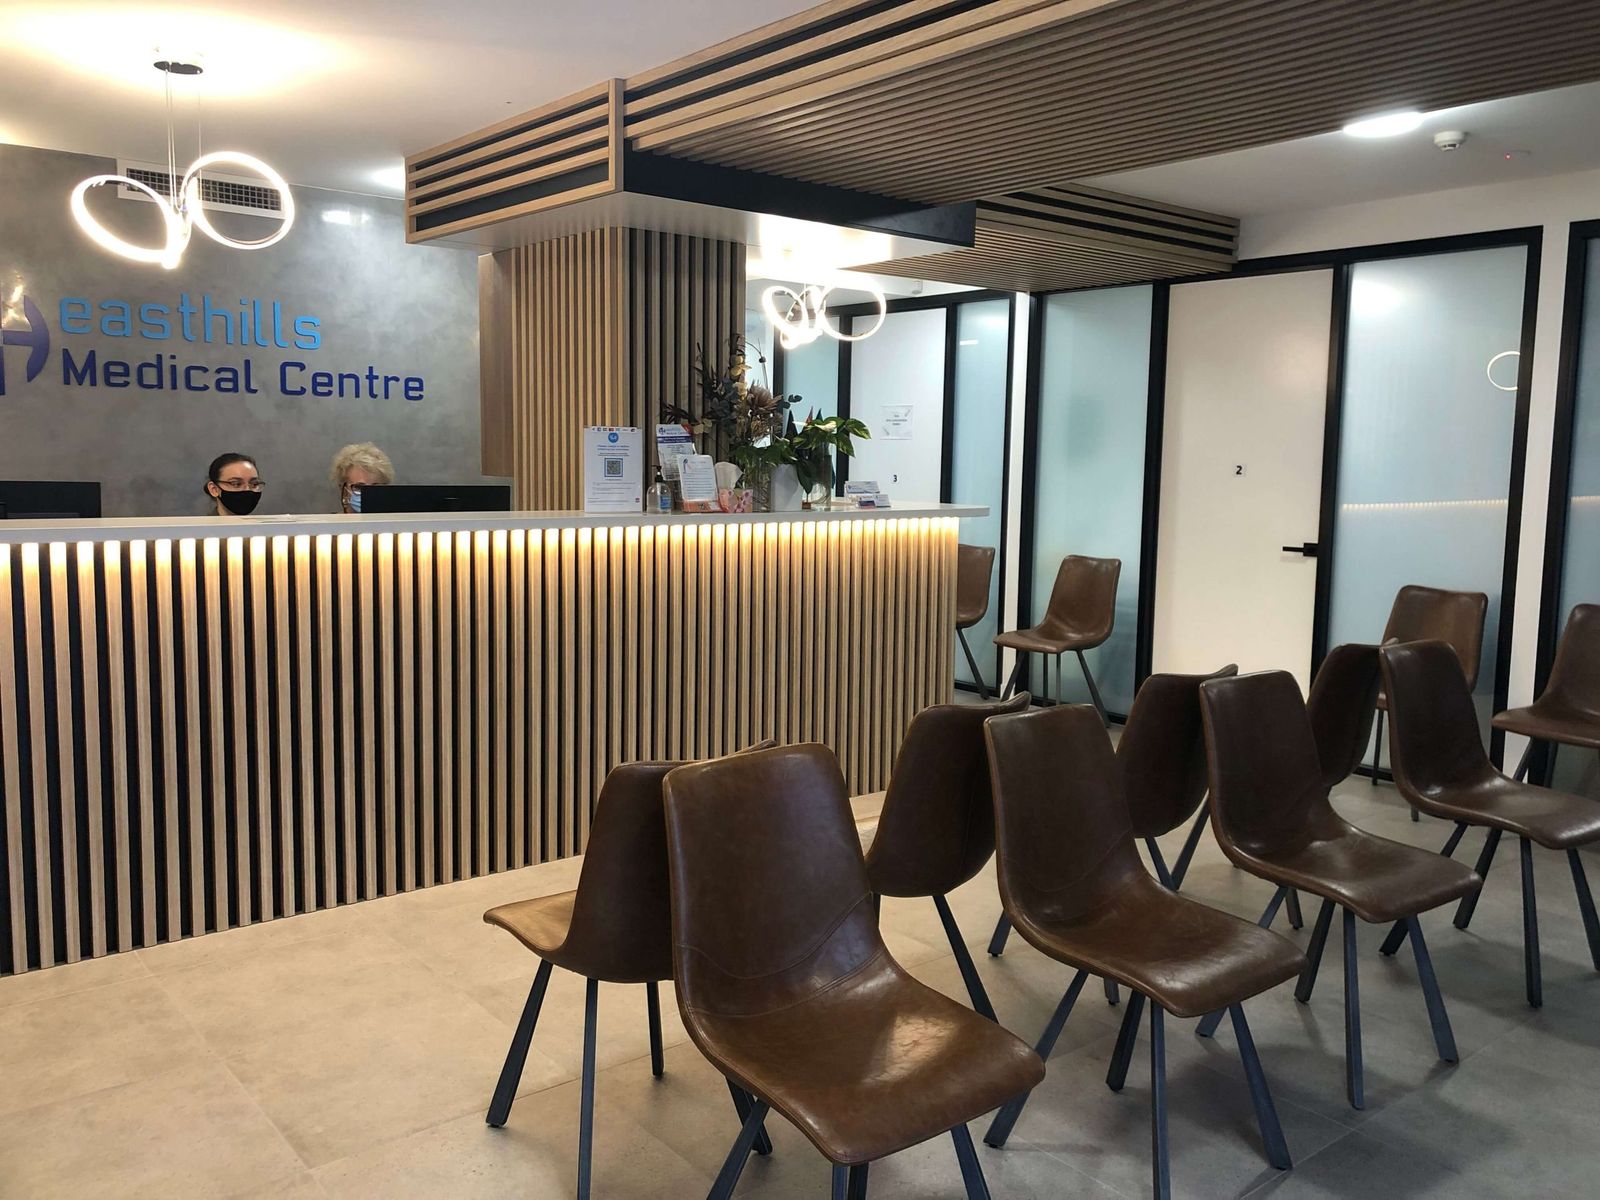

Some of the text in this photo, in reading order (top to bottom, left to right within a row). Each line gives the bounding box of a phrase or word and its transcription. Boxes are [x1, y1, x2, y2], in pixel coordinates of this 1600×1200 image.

[59, 293, 322, 350] easthills
[62, 348, 425, 401] Medical Centre
[1236, 465, 1243, 475] 2
